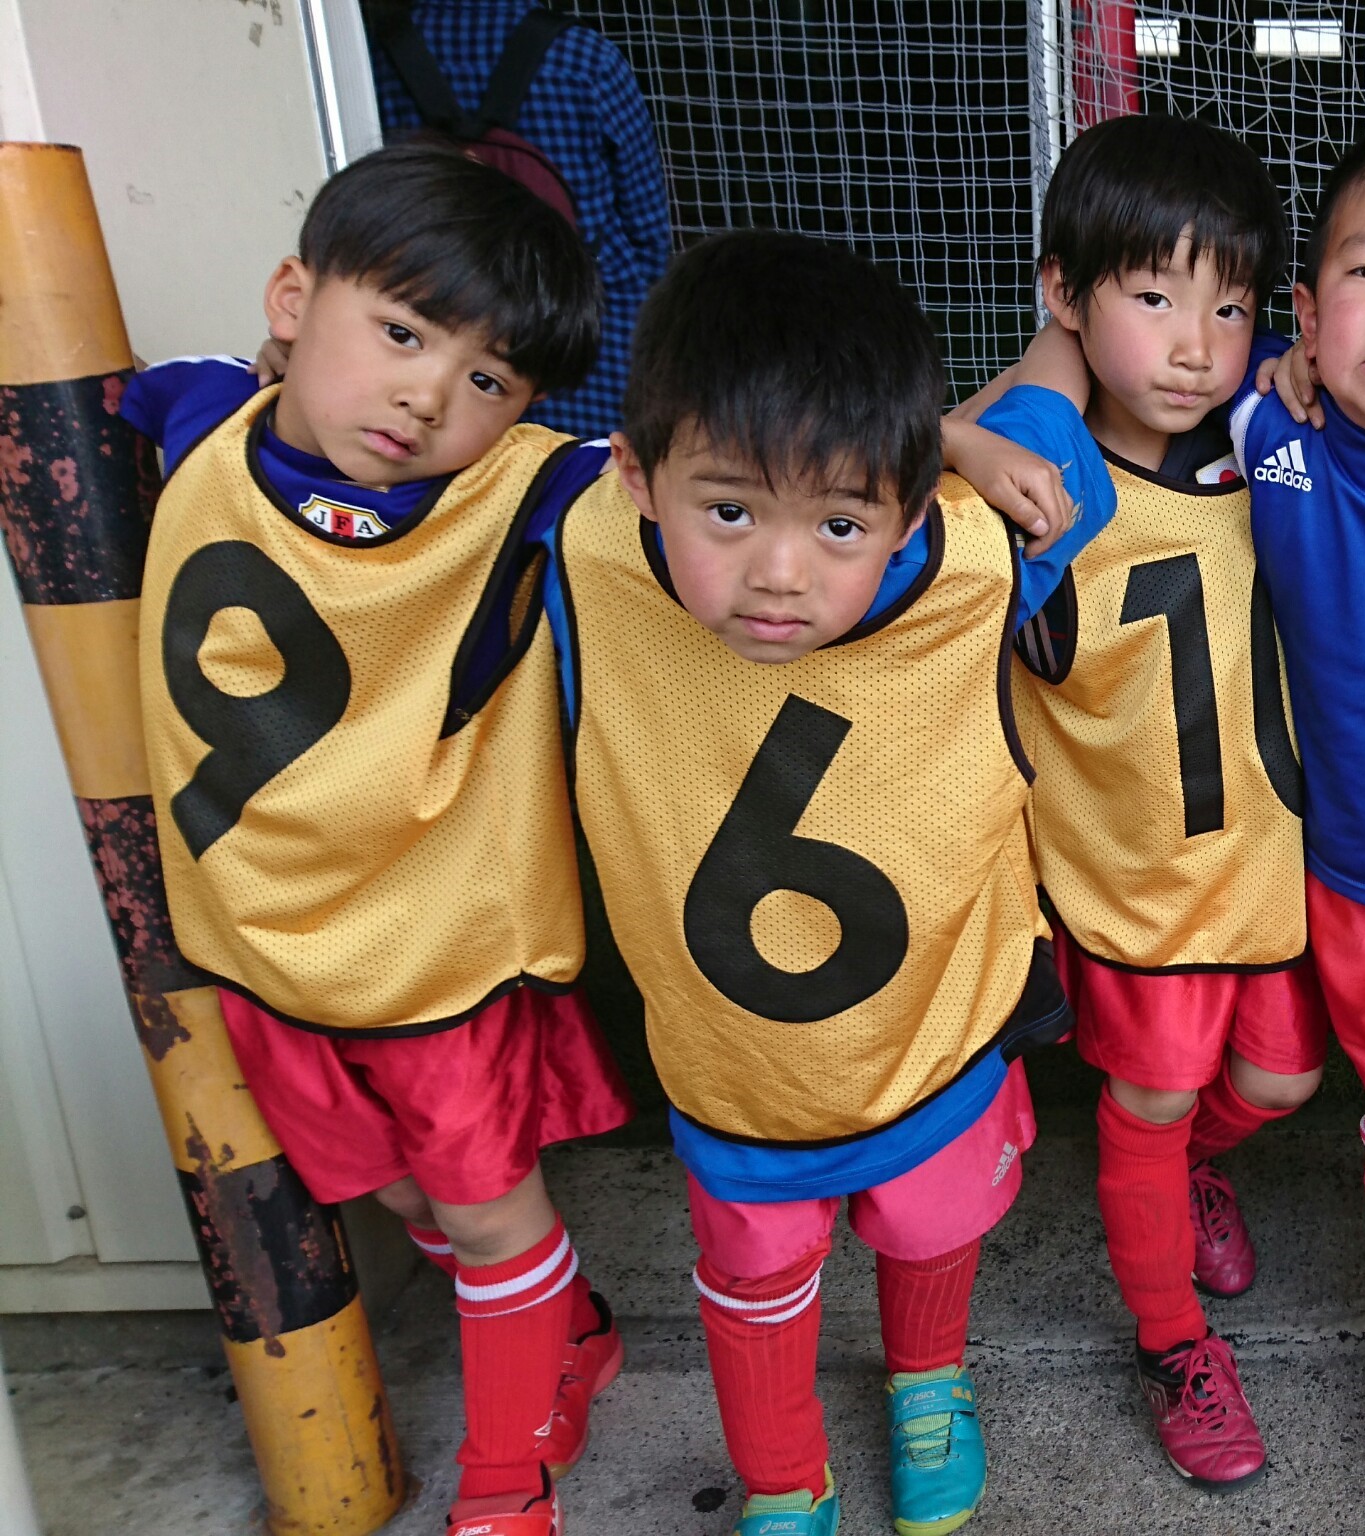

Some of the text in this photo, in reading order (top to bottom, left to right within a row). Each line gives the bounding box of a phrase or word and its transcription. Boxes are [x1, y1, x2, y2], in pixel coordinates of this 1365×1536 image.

[313, 510, 375, 535] JFA
[1254, 465, 1313, 492] adidas
[161, 540, 352, 863] 9
[683, 693, 909, 1024] 6
